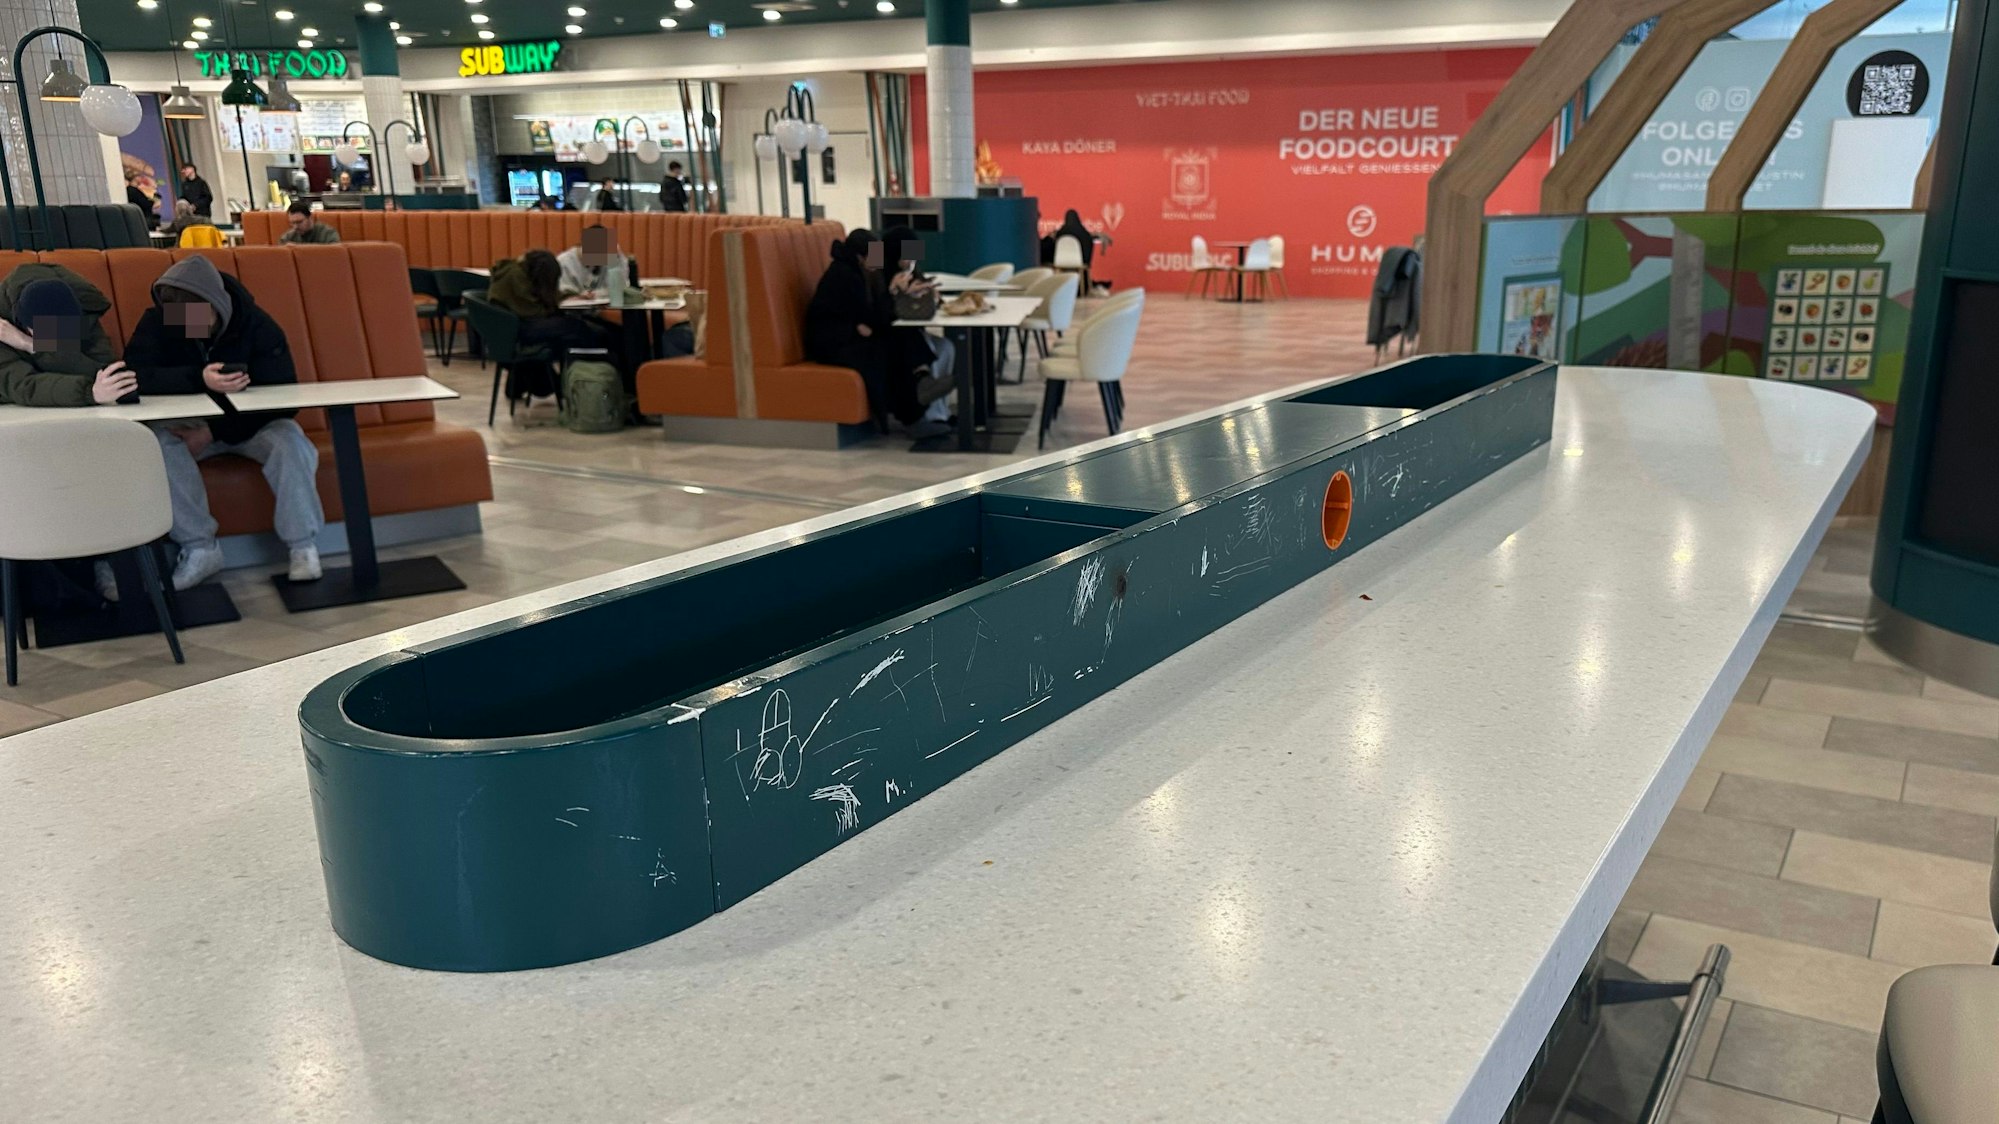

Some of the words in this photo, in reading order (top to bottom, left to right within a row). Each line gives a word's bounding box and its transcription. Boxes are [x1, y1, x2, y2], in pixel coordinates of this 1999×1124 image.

[268, 50, 348, 78] FOOD
[459, 40, 560, 77] SUBWAY
[1208, 89, 1250, 105] FOOD
[1299, 109, 1354, 131] DER
[1361, 107, 1438, 129] NEUE
[1642, 121, 1735, 141] FOLGE
[1022, 141, 1059, 154] KAYA
[1063, 138, 1116, 154] DÖNER
[1279, 134, 1458, 160] FOODCOURT
[1292, 163, 1354, 175] VIELFALT
[1359, 162, 1440, 174] GENIESSEN
[1311, 244, 1385, 263] HUM
